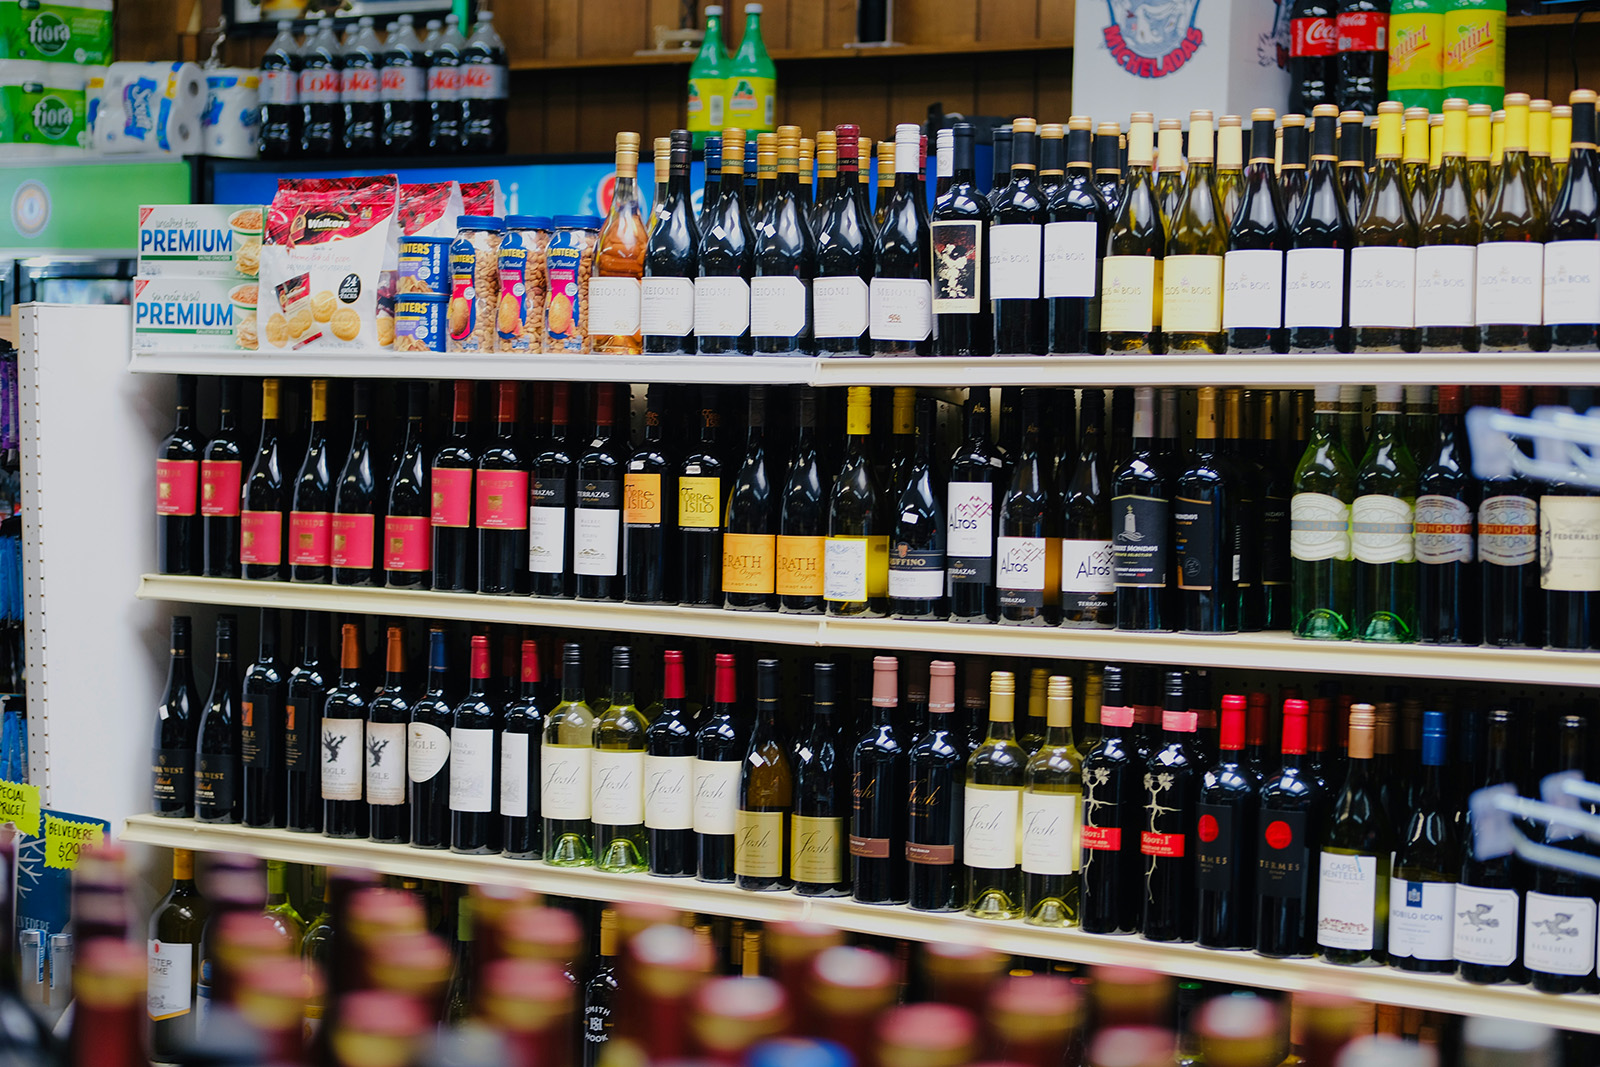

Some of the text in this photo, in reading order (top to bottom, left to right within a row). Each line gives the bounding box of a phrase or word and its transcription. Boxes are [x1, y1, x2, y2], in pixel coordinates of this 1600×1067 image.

[28, 18, 71, 44] fiora
[1103, 24, 1204, 78] MICHELADAS
[1448, 21, 1492, 65] Squirt
[32, 101, 74, 127] fiora
[307, 217, 350, 232] Walkers
[141, 229, 233, 252] PREMIUM
[344, 276, 359, 288] 24
[136, 302, 233, 326] PREMIUM
[577, 490, 611, 499] TERRAZAS
[1553, 532, 1600, 542] FEDERALIS
[723, 552, 763, 570] ERATH
[779, 554, 817, 572] ERATH
[1077, 600, 1108, 608] TERRAZAS
[164, 767, 185, 775] WEST
[544, 760, 580, 793] Josh
[593, 765, 632, 802] Josh
[647, 768, 685, 805] Josh
[694, 773, 727, 804] Josh
[0, 786, 26, 803] PECIAL
[965, 803, 1003, 840] Josh
[1024, 808, 1060, 842] Josh
[49, 822, 95, 841] BELVEDERE
[1143, 833, 1172, 846] Root:1
[736, 825, 770, 858] Josh
[790, 830, 833, 868] Josh
[1258, 859, 1300, 871] TERMES
[1420, 912, 1443, 923] ICON
[585, 1005, 611, 1017] SMITH
[585, 1031, 609, 1043] HOOK
